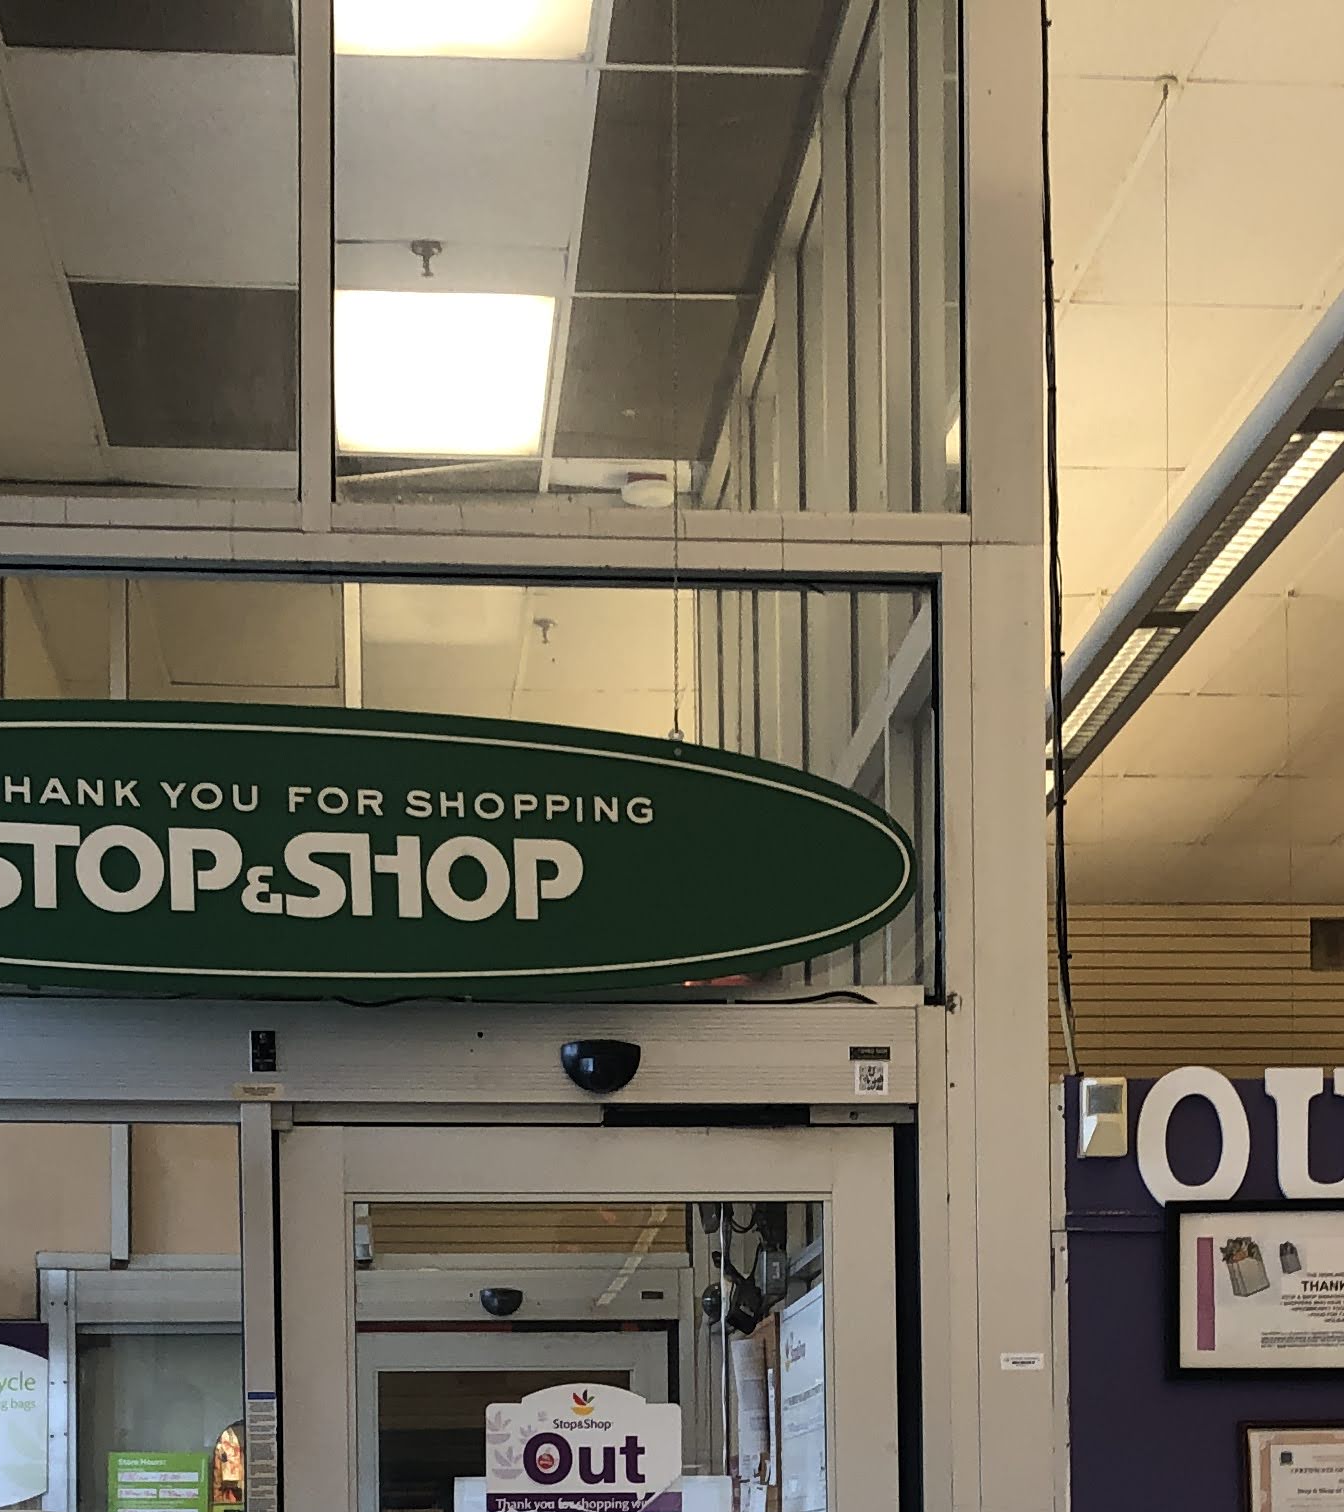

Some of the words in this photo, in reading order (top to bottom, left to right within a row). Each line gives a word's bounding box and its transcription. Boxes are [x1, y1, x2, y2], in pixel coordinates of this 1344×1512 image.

[159, 782, 260, 812] YOU
[288, 786, 384, 817] FOR
[405, 790, 655, 824] SHOPPING
[552, 1418, 612, 1432] Stop&Shop
[522, 1432, 646, 1485] Out
[496, 1498, 531, 1512] Thank
